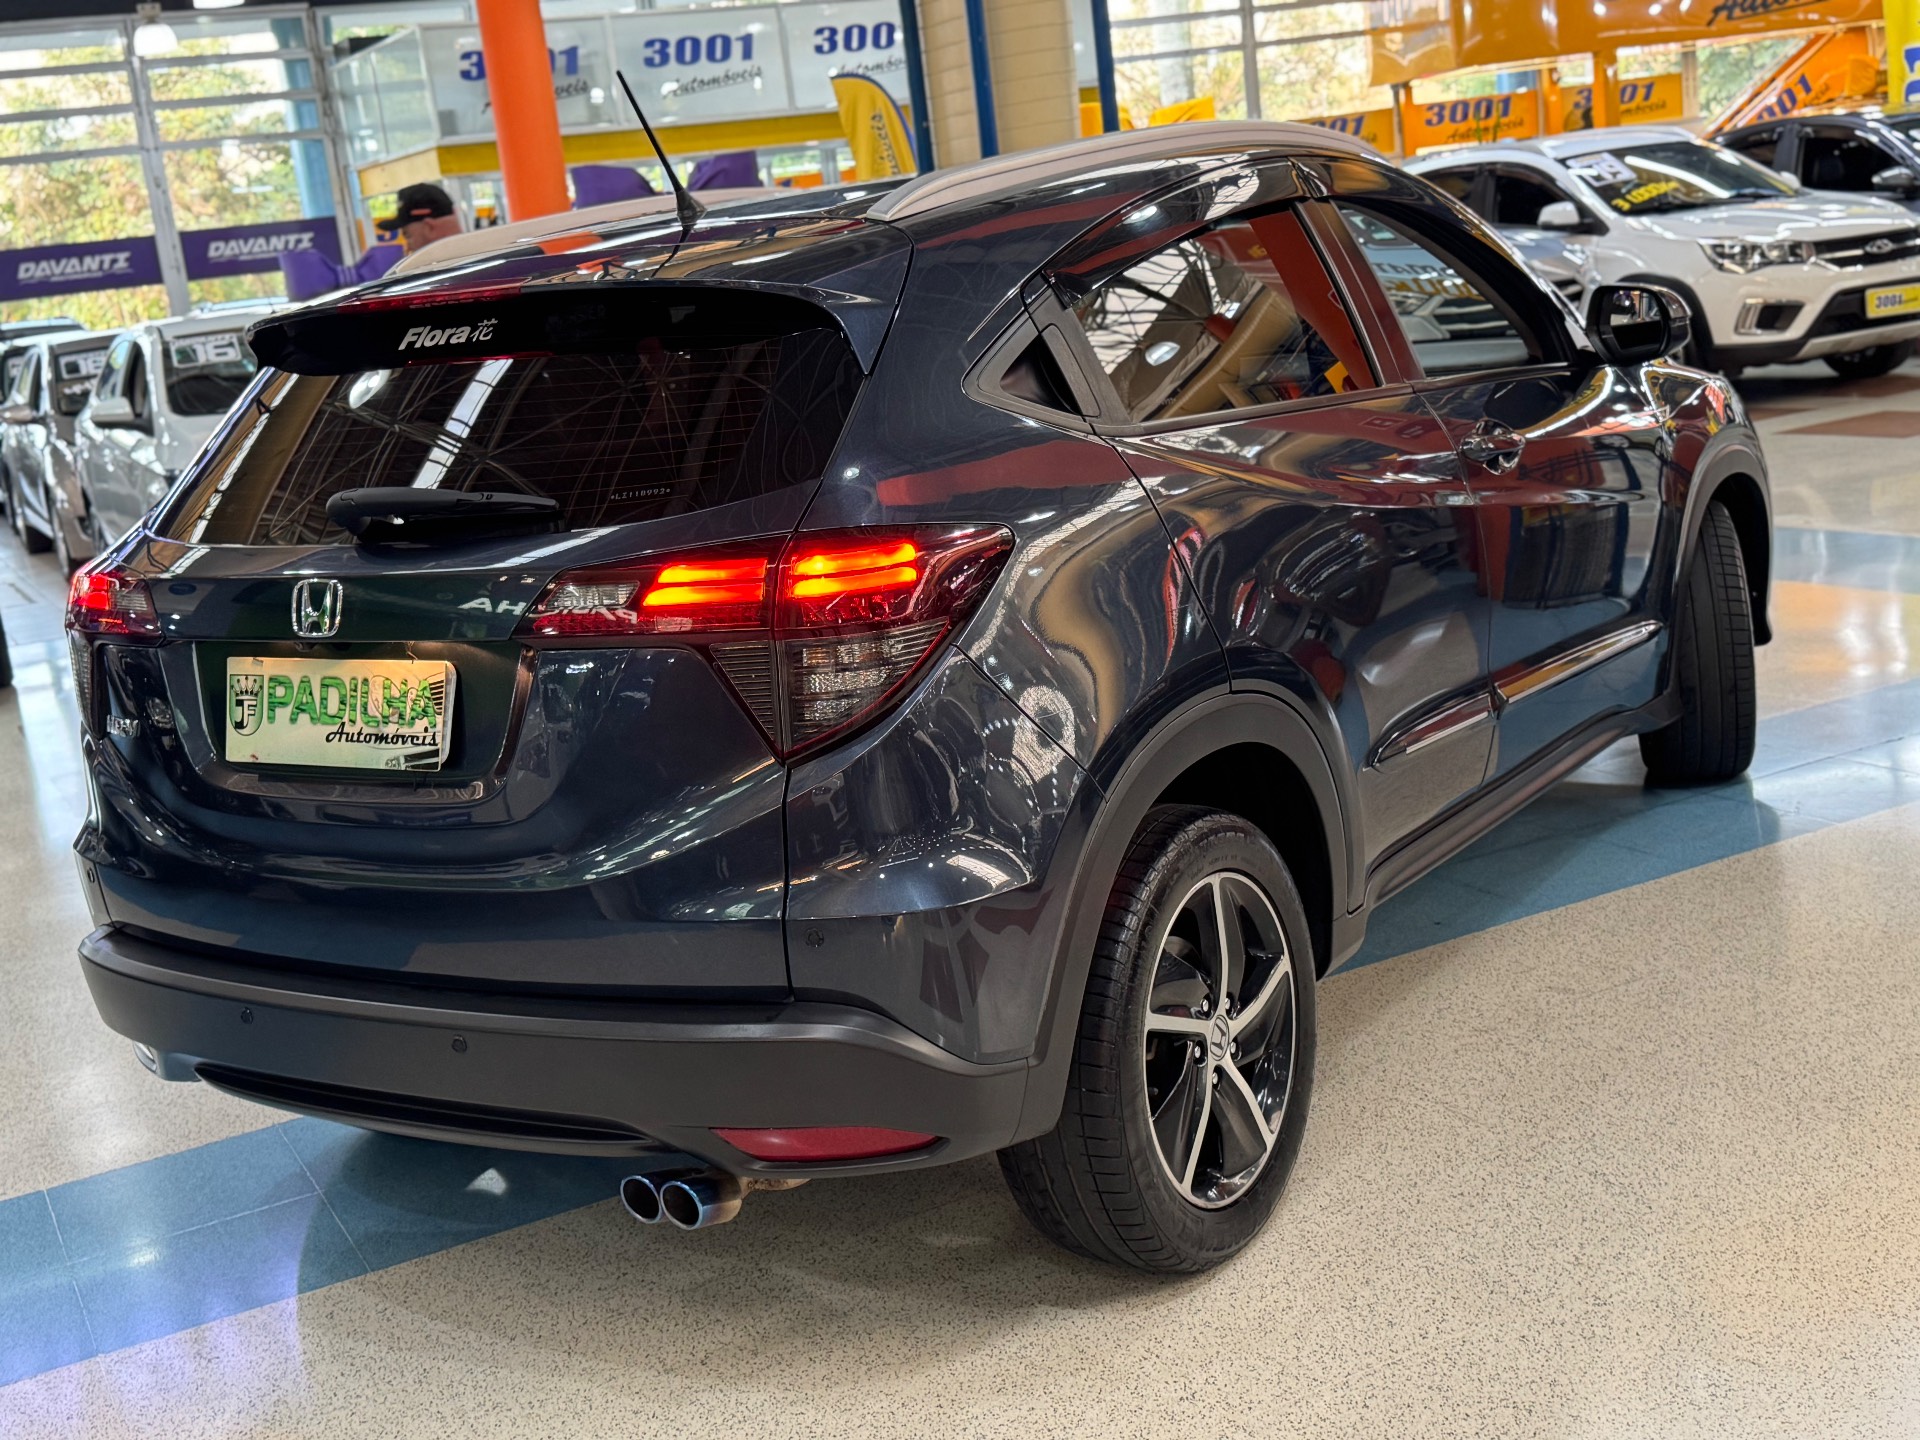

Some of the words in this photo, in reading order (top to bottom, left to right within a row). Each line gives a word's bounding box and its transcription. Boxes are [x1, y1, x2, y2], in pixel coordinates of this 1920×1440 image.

[643, 33, 754, 68] 3001
[814, 22, 896, 54] 300
[1425, 96, 1512, 127] 3001
[206, 231, 315, 259] DAVANTI
[16, 251, 132, 280] DAVANTI
[398, 325, 472, 351] Flora
[470, 318, 499, 342] 花
[267, 675, 437, 728] PADILHA
[326, 721, 439, 747] Automóveis
